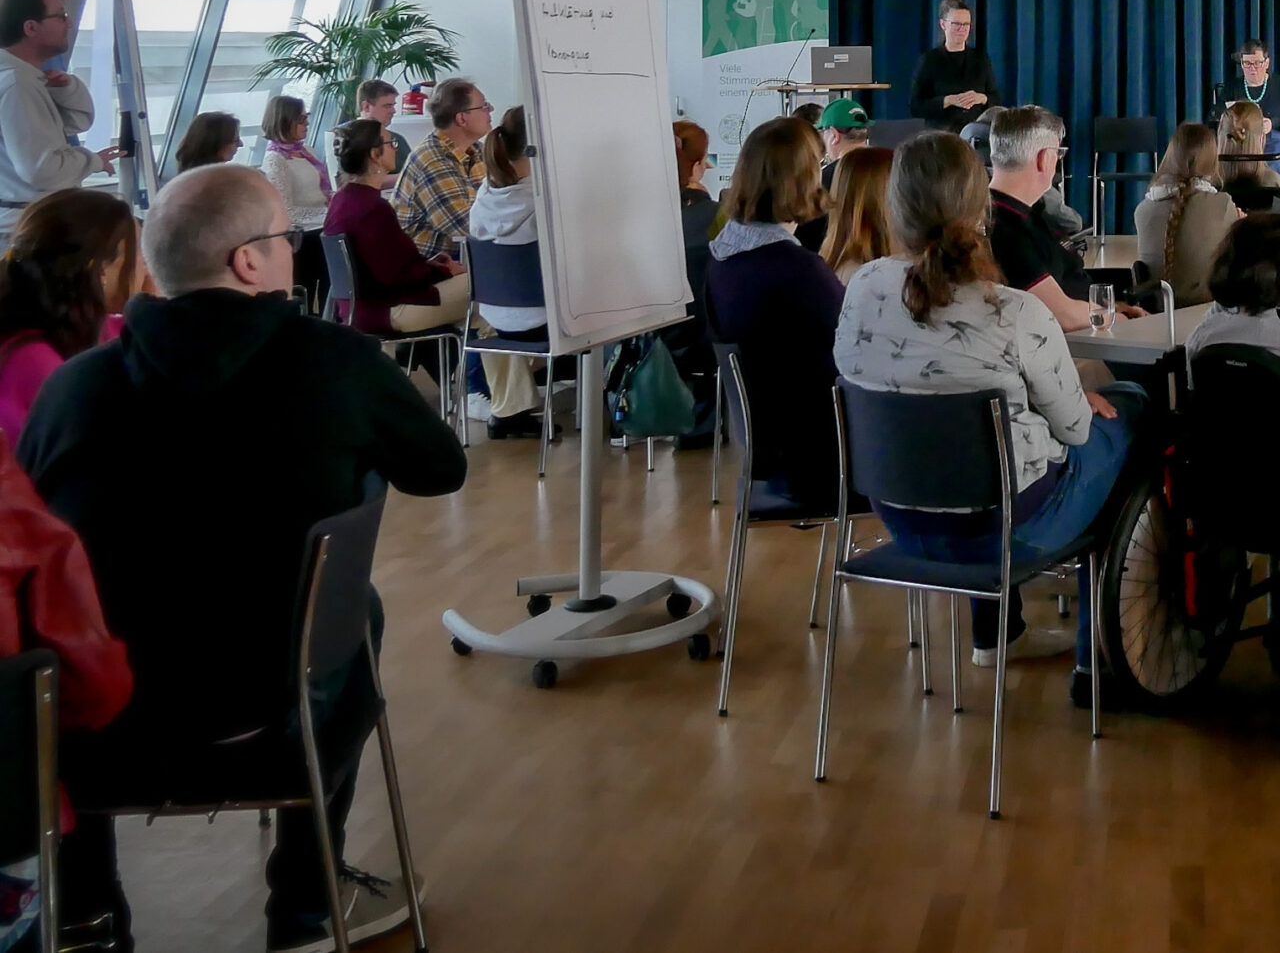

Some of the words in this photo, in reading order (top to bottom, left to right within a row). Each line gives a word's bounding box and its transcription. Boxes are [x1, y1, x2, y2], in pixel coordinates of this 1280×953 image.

[719, 63, 743, 74] Viele
[719, 76, 762, 86] Stimmen
[719, 89, 749, 97] einem
